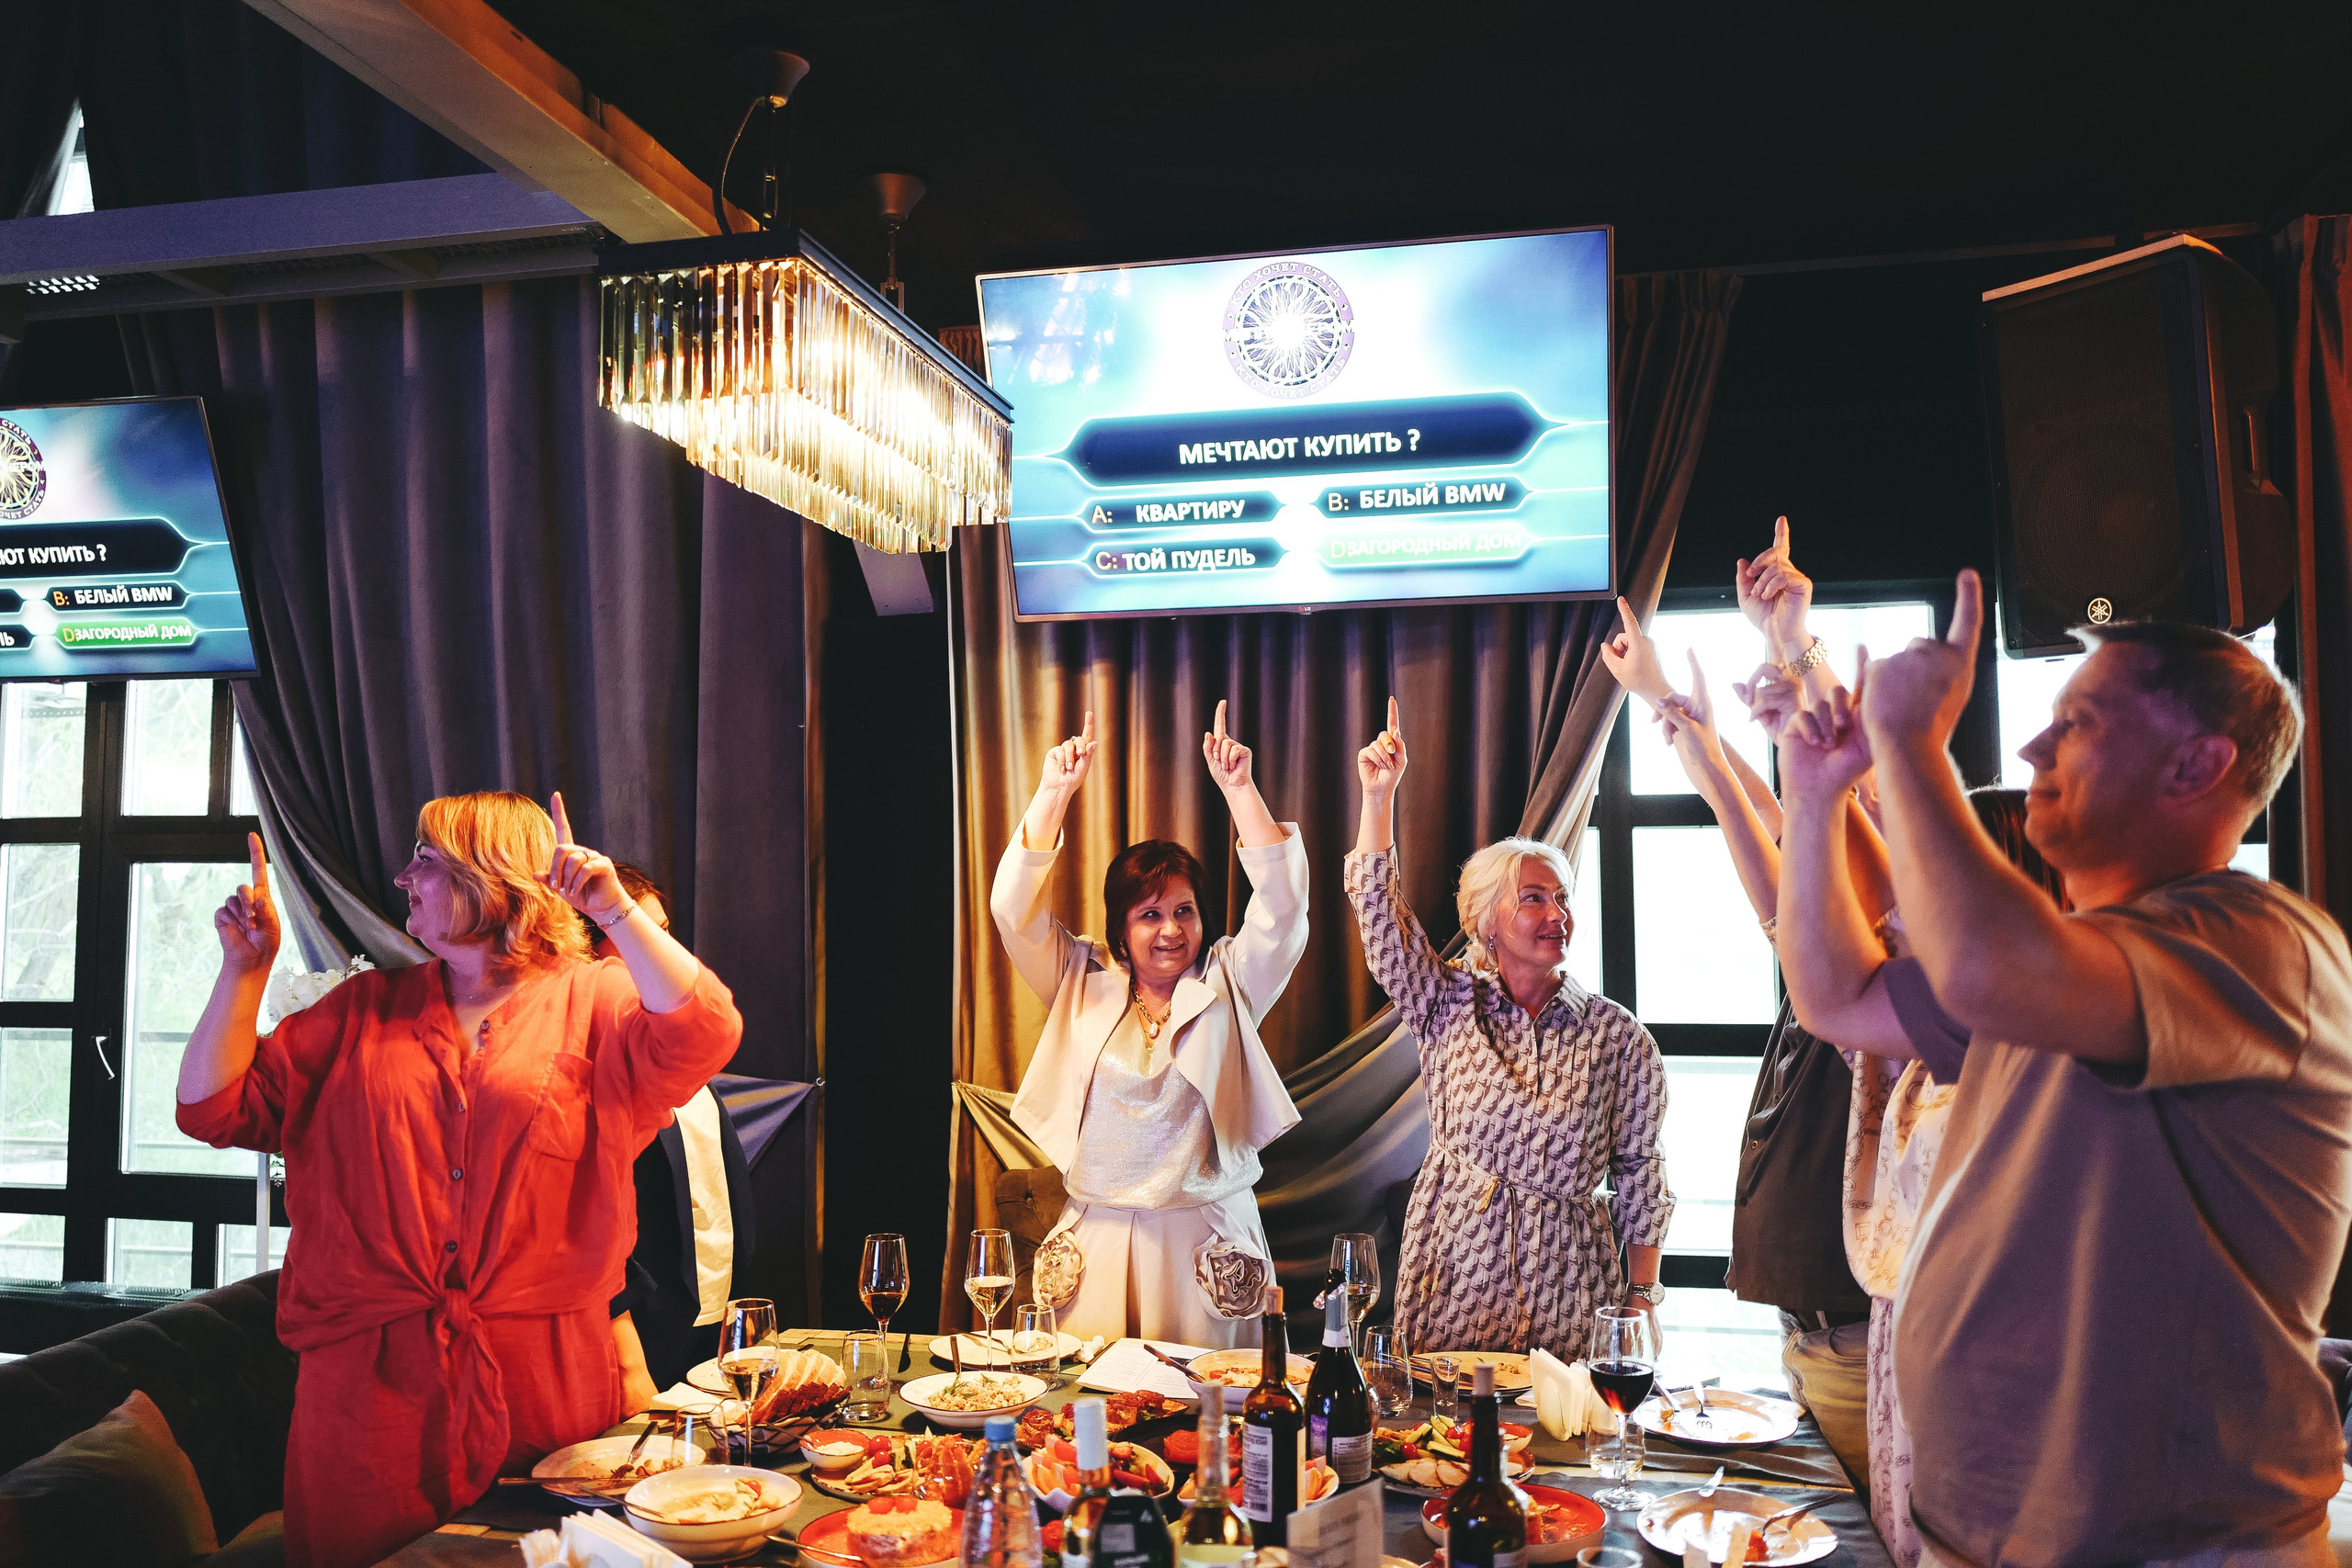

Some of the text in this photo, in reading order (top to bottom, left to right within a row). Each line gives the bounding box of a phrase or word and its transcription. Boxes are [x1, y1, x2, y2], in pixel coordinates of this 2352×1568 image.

[1230, 262, 1342, 306] КТО ХОЧЕТ СТАТЬ
[2, 419, 31, 445] СТАТЬ
[1179, 428, 1420, 465] МЕЧТАЮТ КУПИТЬ ?
[1359, 481, 1439, 509] БЕЛЫЙ
[1444, 482, 1506, 504] BMW
[1136, 500, 1245, 524] КВАРТИРУ
[0, 544, 107, 565] ЮТ КУПИТЬ ?
[1475, 533, 1521, 553] ДОМ
[1122, 547, 1166, 571] ТОЙ
[1171, 548, 1256, 571] ПУДЕЛЬ
[74, 584, 129, 604] БЕЛЫЙ
[131, 586, 173, 603] BMW
[161, 625, 192, 640] ДОМ
